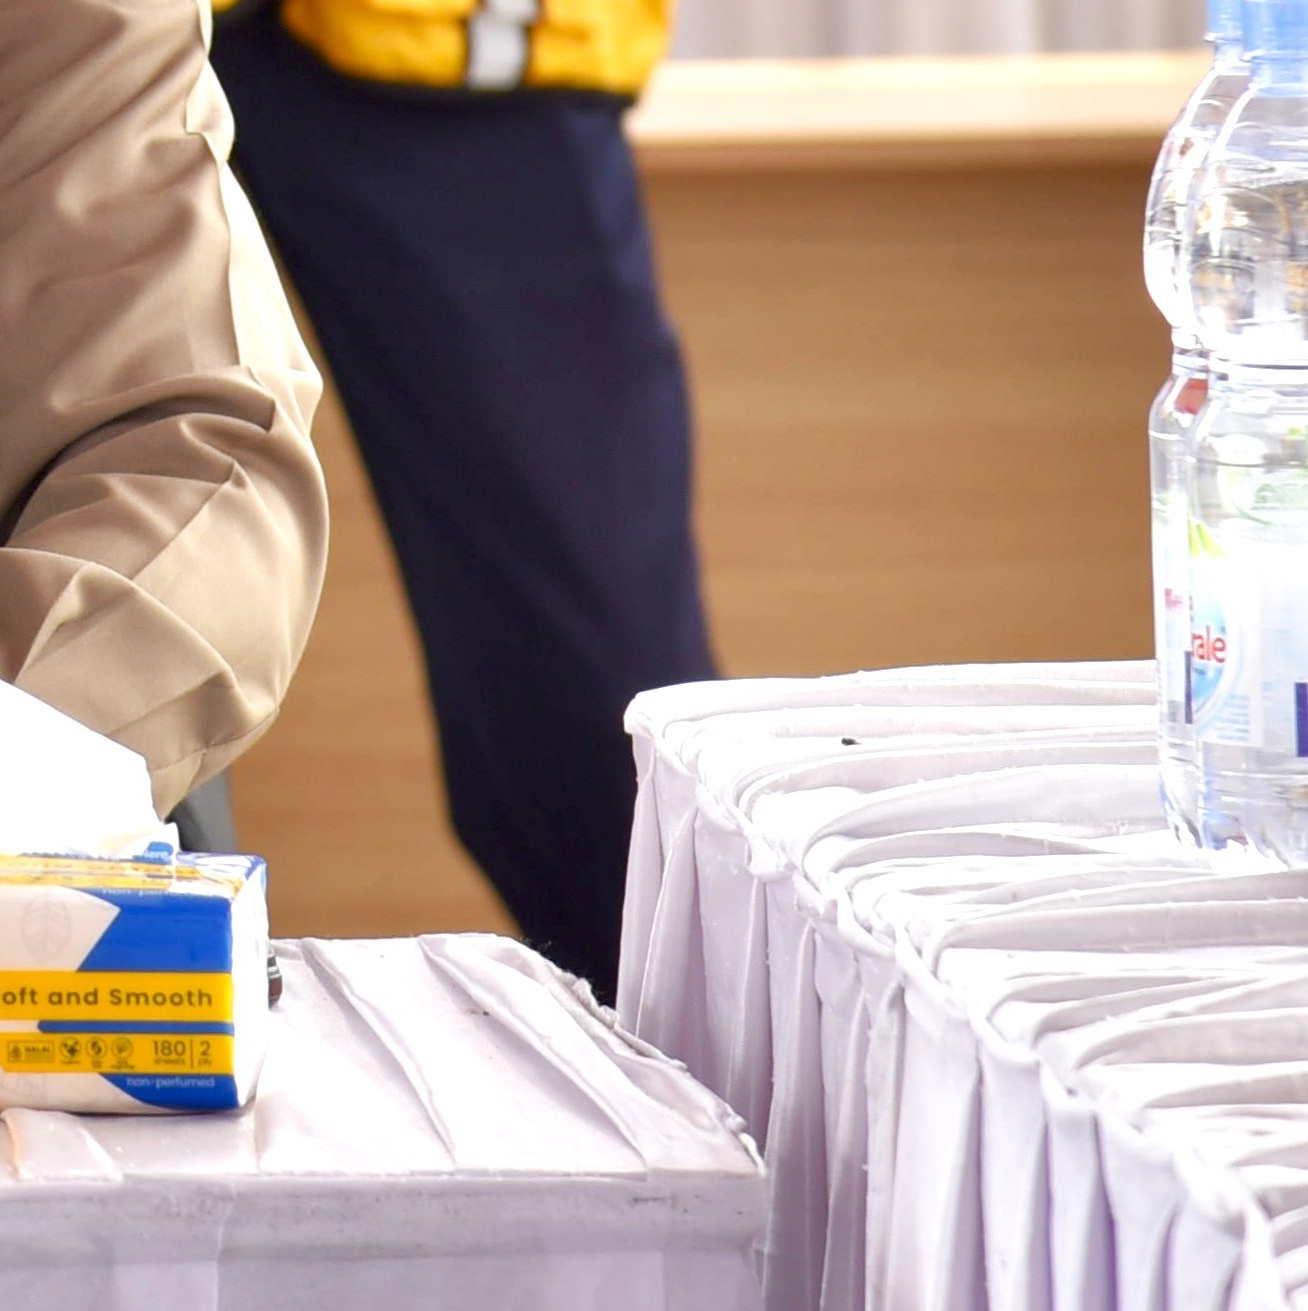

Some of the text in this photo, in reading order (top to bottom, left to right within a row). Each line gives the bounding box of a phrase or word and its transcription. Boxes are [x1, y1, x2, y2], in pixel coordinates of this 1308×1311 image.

[48, 988, 99, 1006] and
[110, 988, 213, 1007] Smooth
[153, 1040, 186, 1056] 180
[200, 1040, 211, 1056] 2
[126, 1076, 216, 1090] non-perfumed
